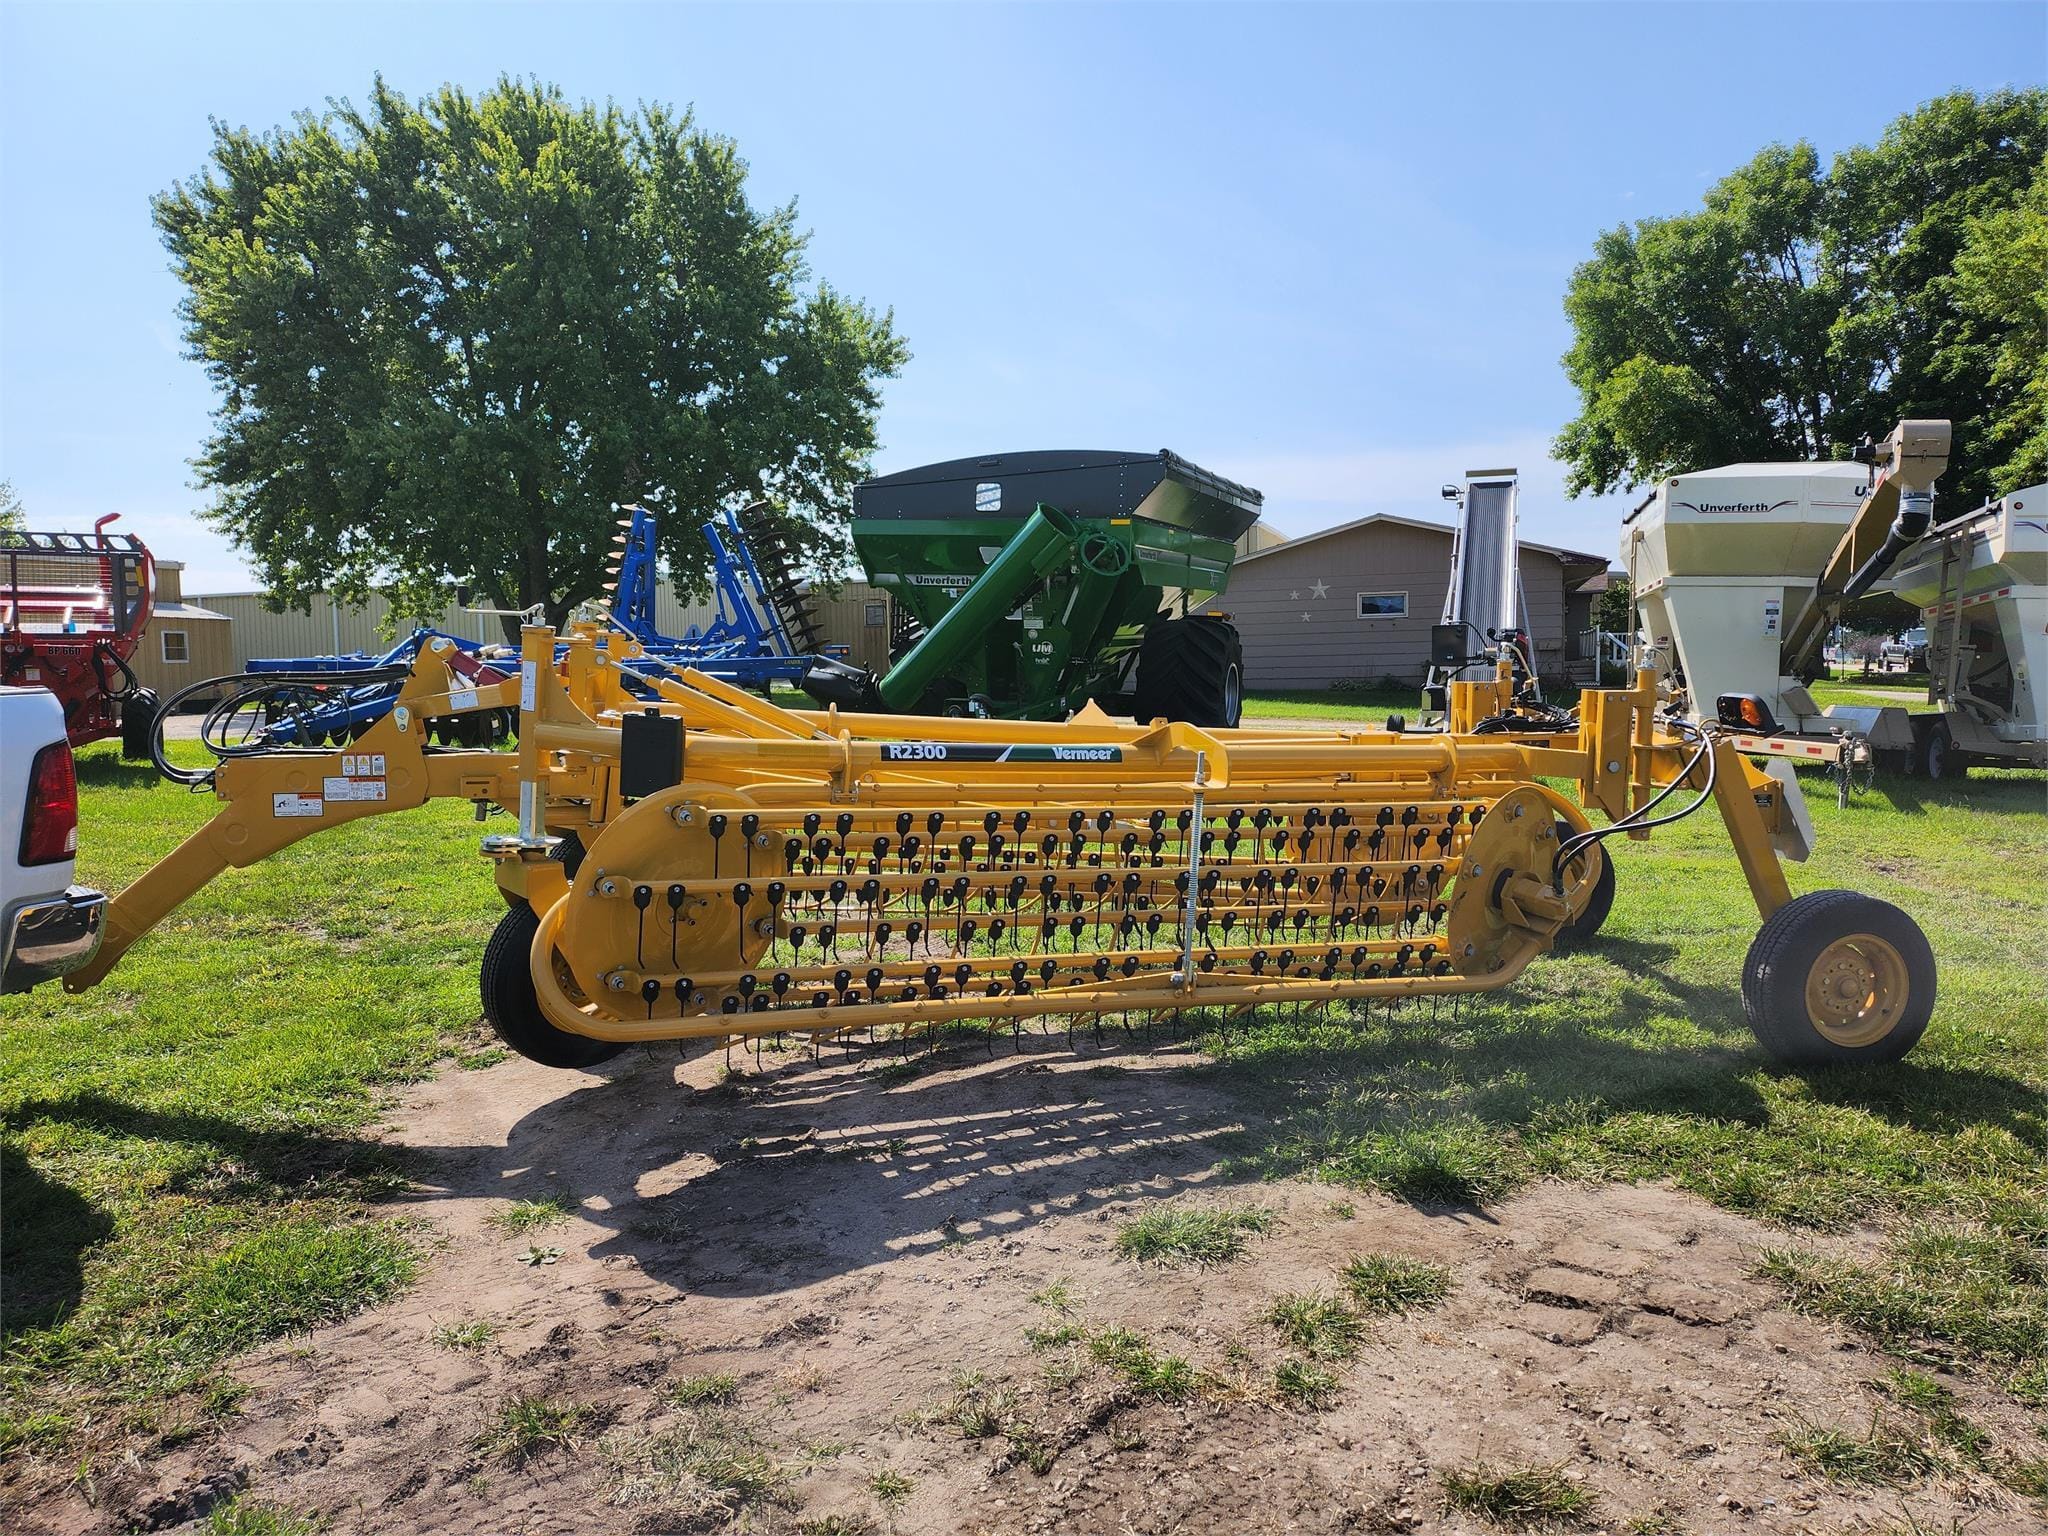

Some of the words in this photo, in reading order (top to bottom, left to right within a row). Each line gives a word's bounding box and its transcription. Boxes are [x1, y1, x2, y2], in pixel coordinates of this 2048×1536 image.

[1700, 503, 1768, 512] Unverferth
[916, 575, 972, 585] Unverferth
[889, 745, 947, 759] R2300
[1052, 747, 1113, 760] Vermeer
